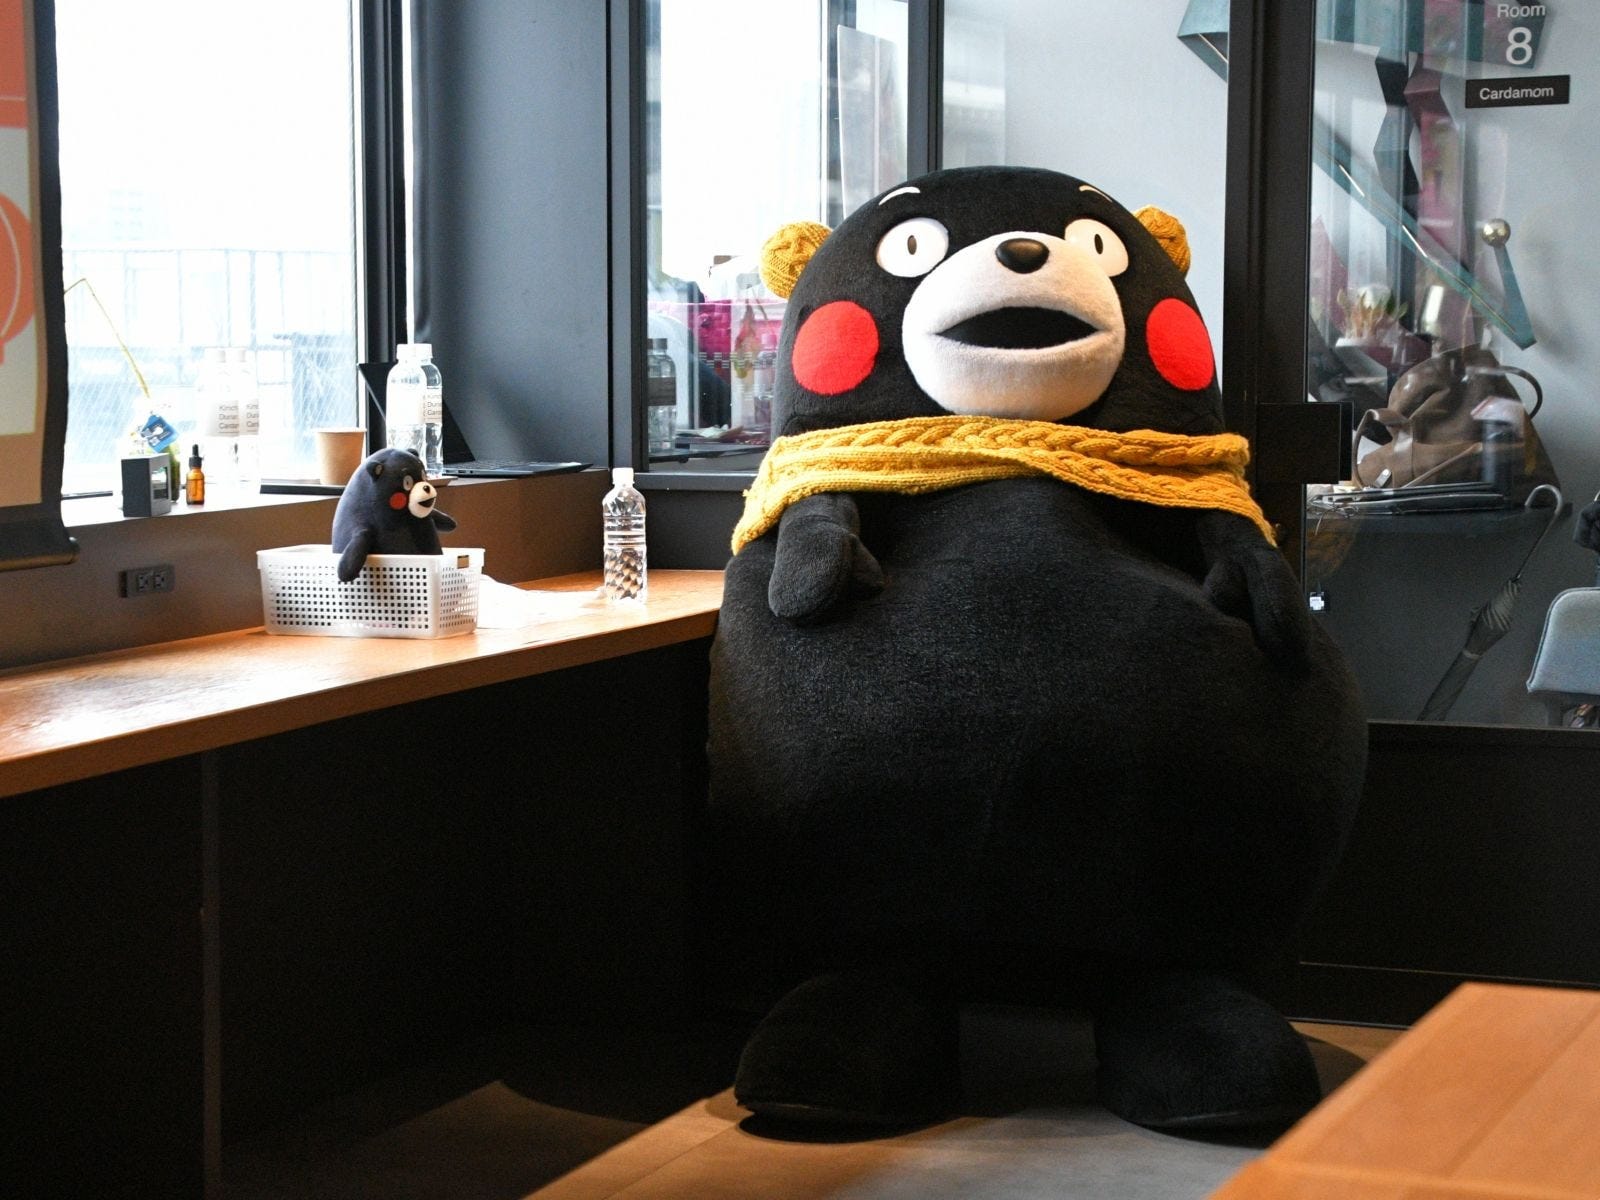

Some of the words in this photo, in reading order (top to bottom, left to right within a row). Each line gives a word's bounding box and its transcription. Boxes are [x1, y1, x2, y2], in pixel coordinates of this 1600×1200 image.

[1497, 3, 1546, 18] Room
[1505, 26, 1533, 65] 8
[1479, 86, 1554, 100] Cardamom
